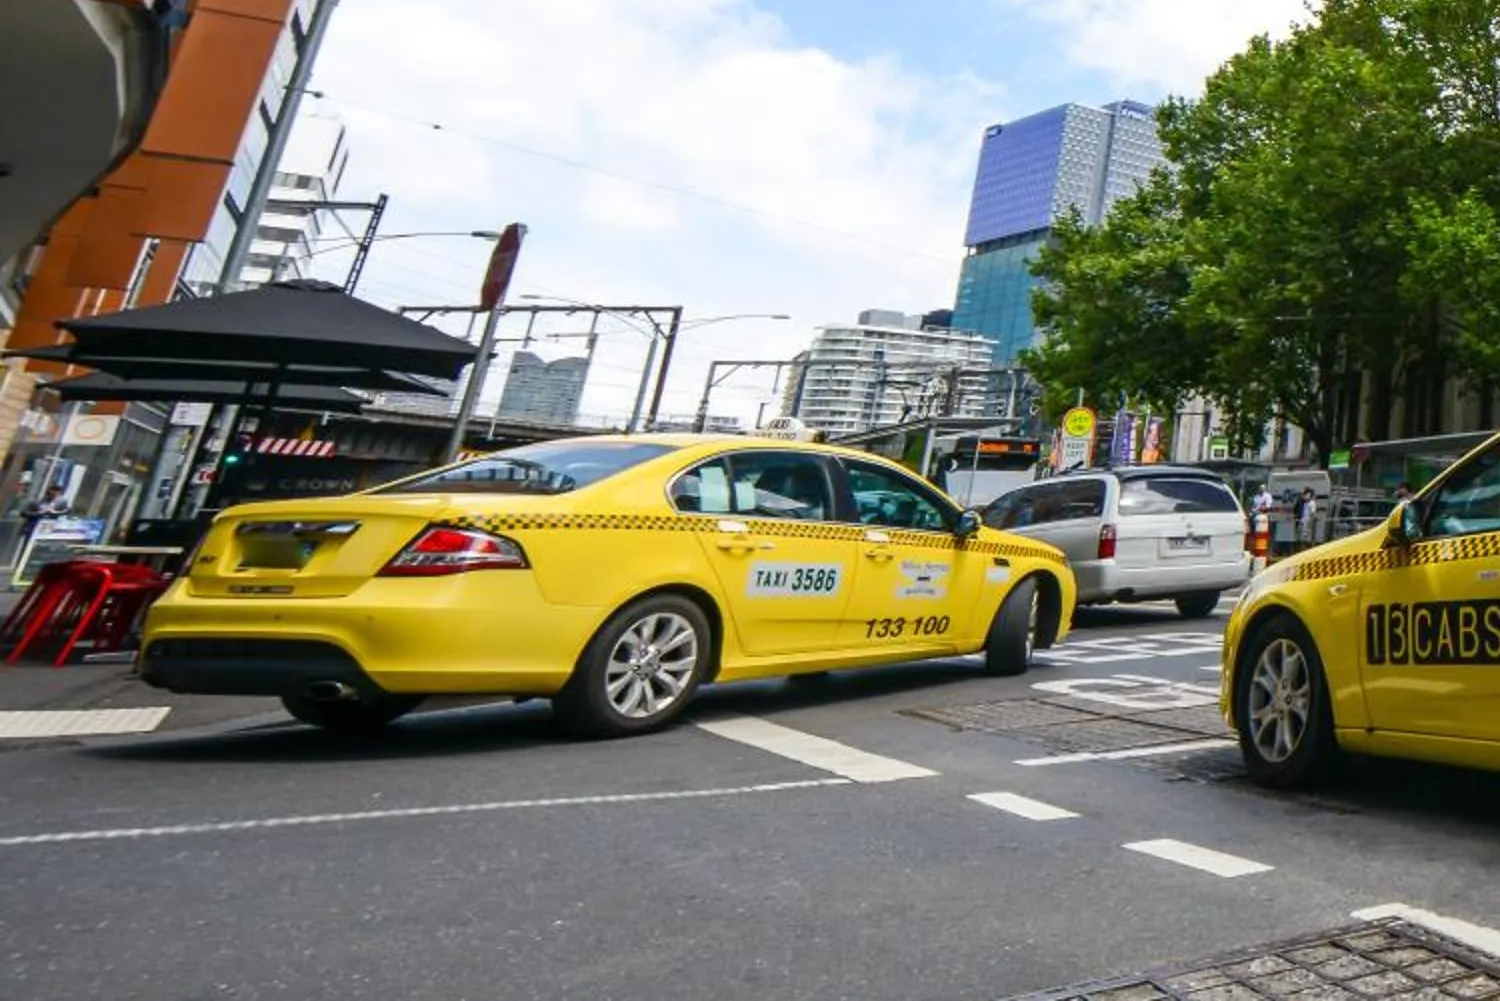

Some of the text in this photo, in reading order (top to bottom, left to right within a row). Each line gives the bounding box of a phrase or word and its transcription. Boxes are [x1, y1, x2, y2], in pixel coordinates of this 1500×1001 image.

[278, 477, 354, 491] CROWN
[756, 567, 837, 592] TAXI 3586
[865, 615, 951, 639] 133 100
